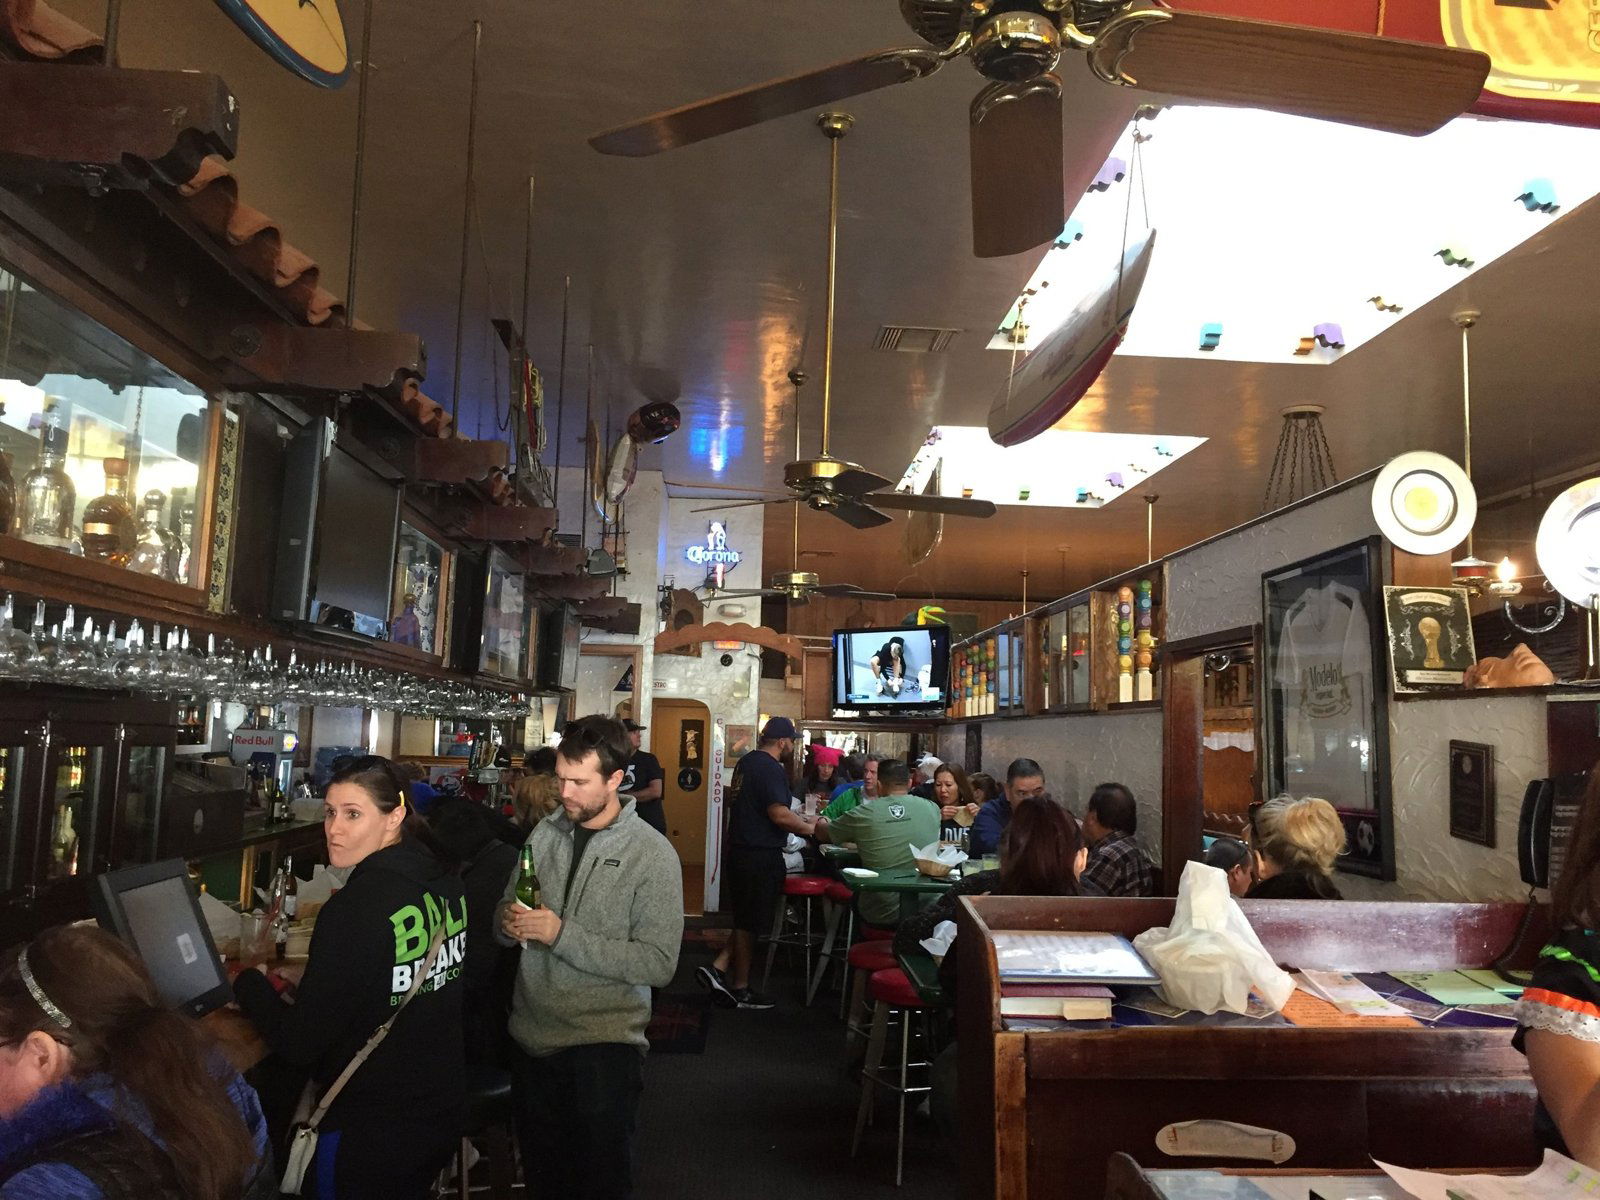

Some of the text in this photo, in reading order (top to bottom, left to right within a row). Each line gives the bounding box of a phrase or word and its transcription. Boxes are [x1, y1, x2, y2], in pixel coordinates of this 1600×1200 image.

[687, 545, 739, 564] Corona
[1309, 662, 1338, 691] Modelo
[235, 736, 273, 745] Red Bull
[713, 750, 722, 804] CUIDADO
